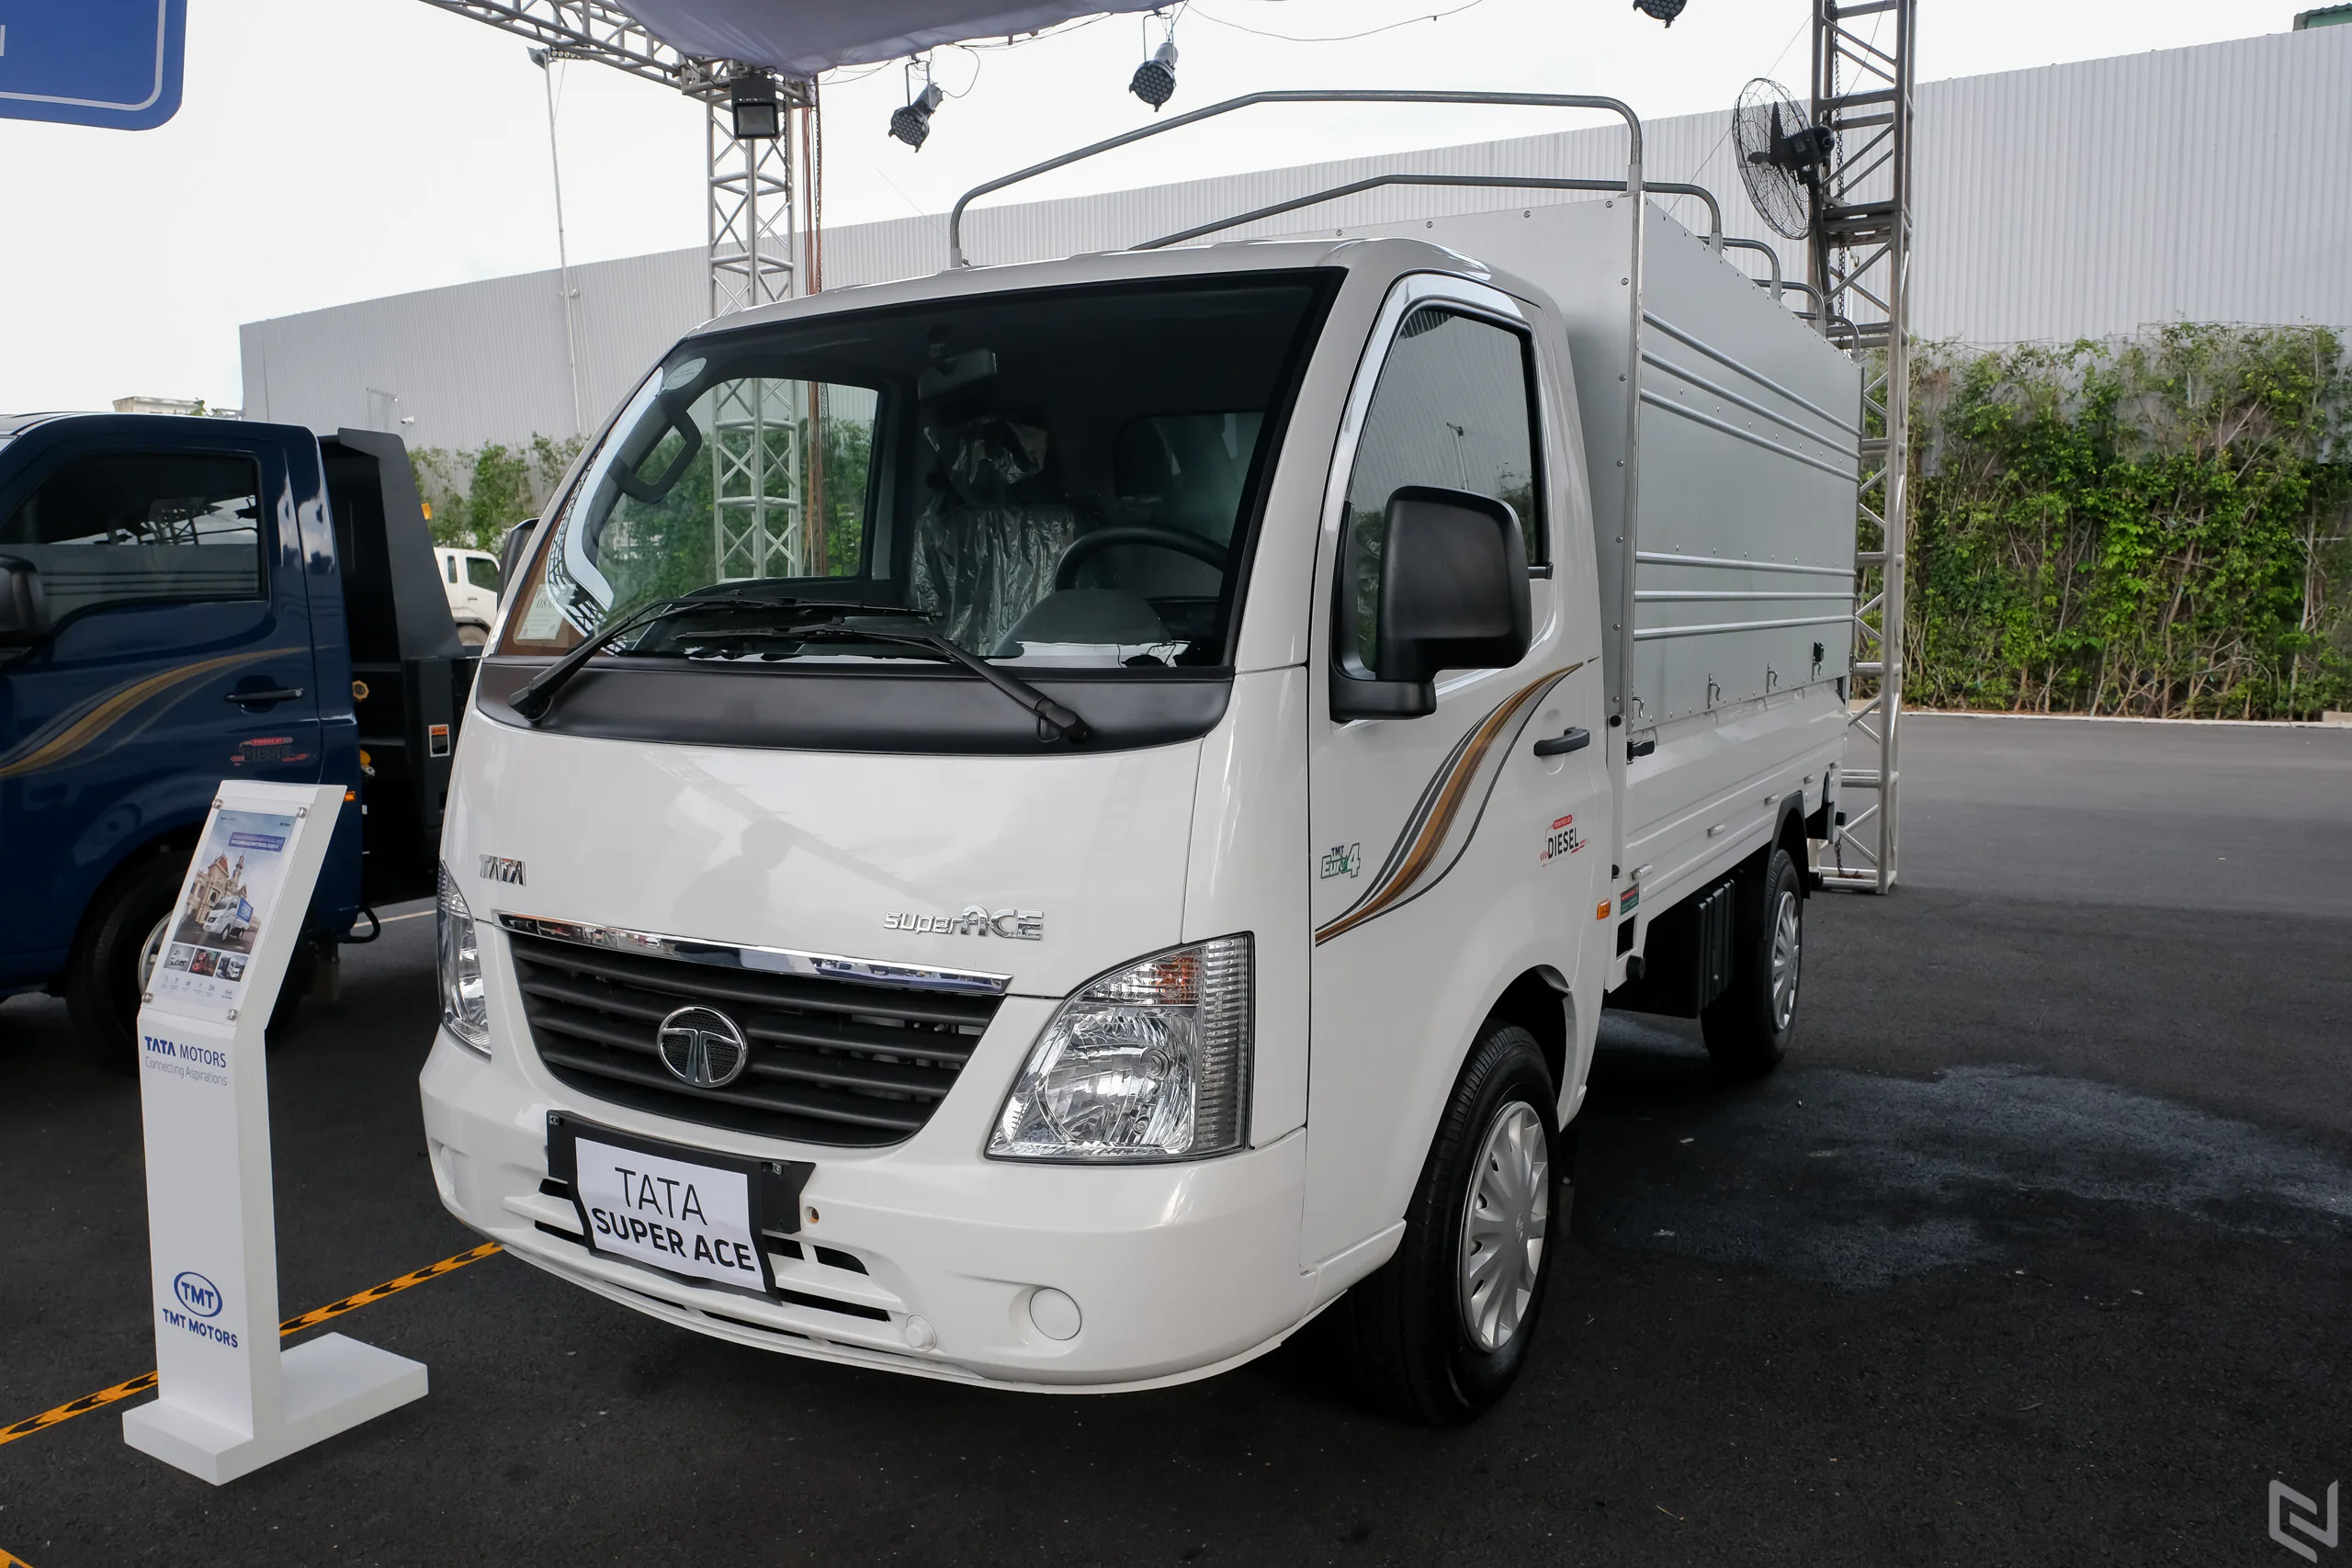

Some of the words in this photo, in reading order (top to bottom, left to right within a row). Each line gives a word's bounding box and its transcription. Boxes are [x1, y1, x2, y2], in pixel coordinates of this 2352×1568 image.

[243, 745, 296, 762] DIESEL
[1331, 844, 1344, 857] TMT
[1547, 827, 1579, 859] DIESEL
[479, 853, 527, 886] TATA
[144, 1035, 176, 1056] TATA
[179, 1043, 226, 1068] MOTORS
[145, 1055, 185, 1079] Connecting
[186, 1066, 228, 1087] Aspirations
[615, 1167, 708, 1226] TATA
[591, 1207, 687, 1258] SUPER
[694, 1234, 756, 1272] ACE
[181, 1280, 215, 1309] TMT
[163, 1307, 187, 1329] TMT
[188, 1317, 239, 1348] MOTORS
